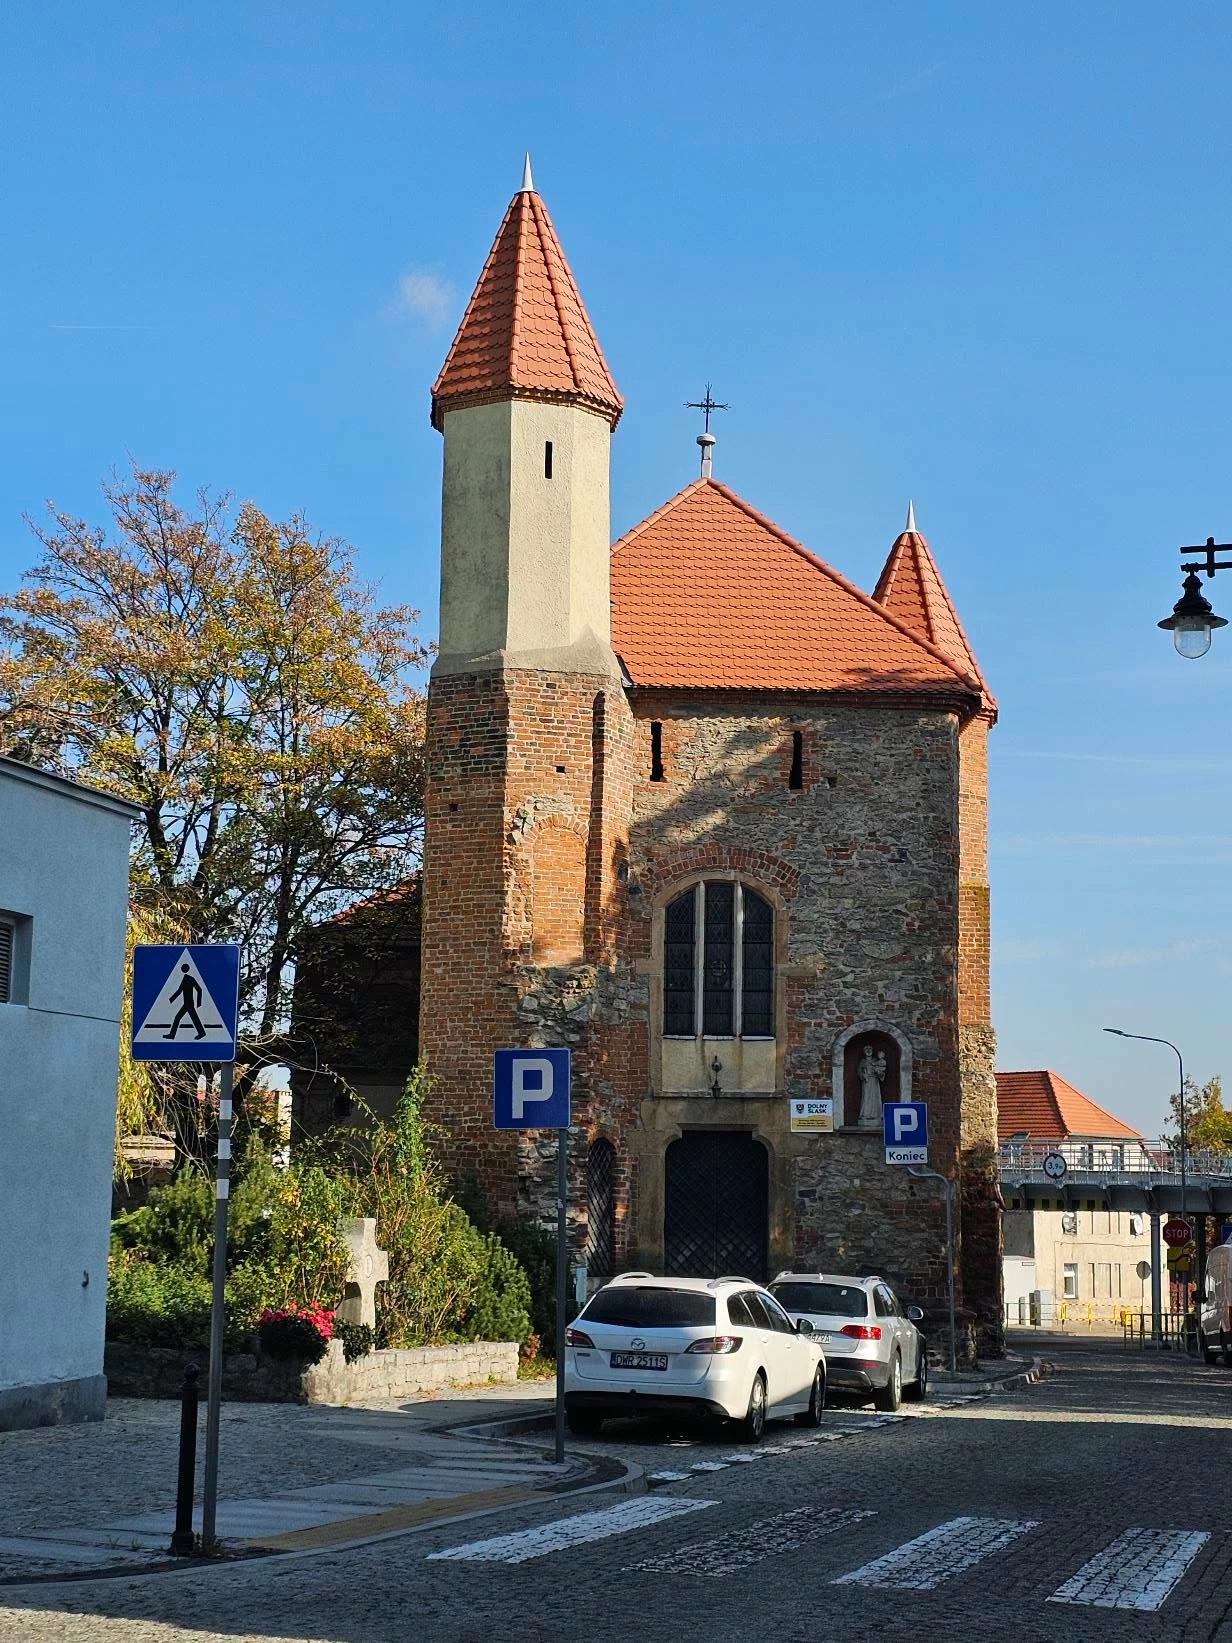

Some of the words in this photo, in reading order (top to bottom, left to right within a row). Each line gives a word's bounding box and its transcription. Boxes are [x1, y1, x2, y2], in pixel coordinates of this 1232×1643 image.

[512, 1059, 553, 1118] P
[894, 1108, 918, 1141] P
[889, 1151, 925, 1161] Koniec
[1165, 1229, 1188, 1238] STOP
[616, 1354, 634, 1366] DWR
[637, 1355, 666, 1368] 2511S
